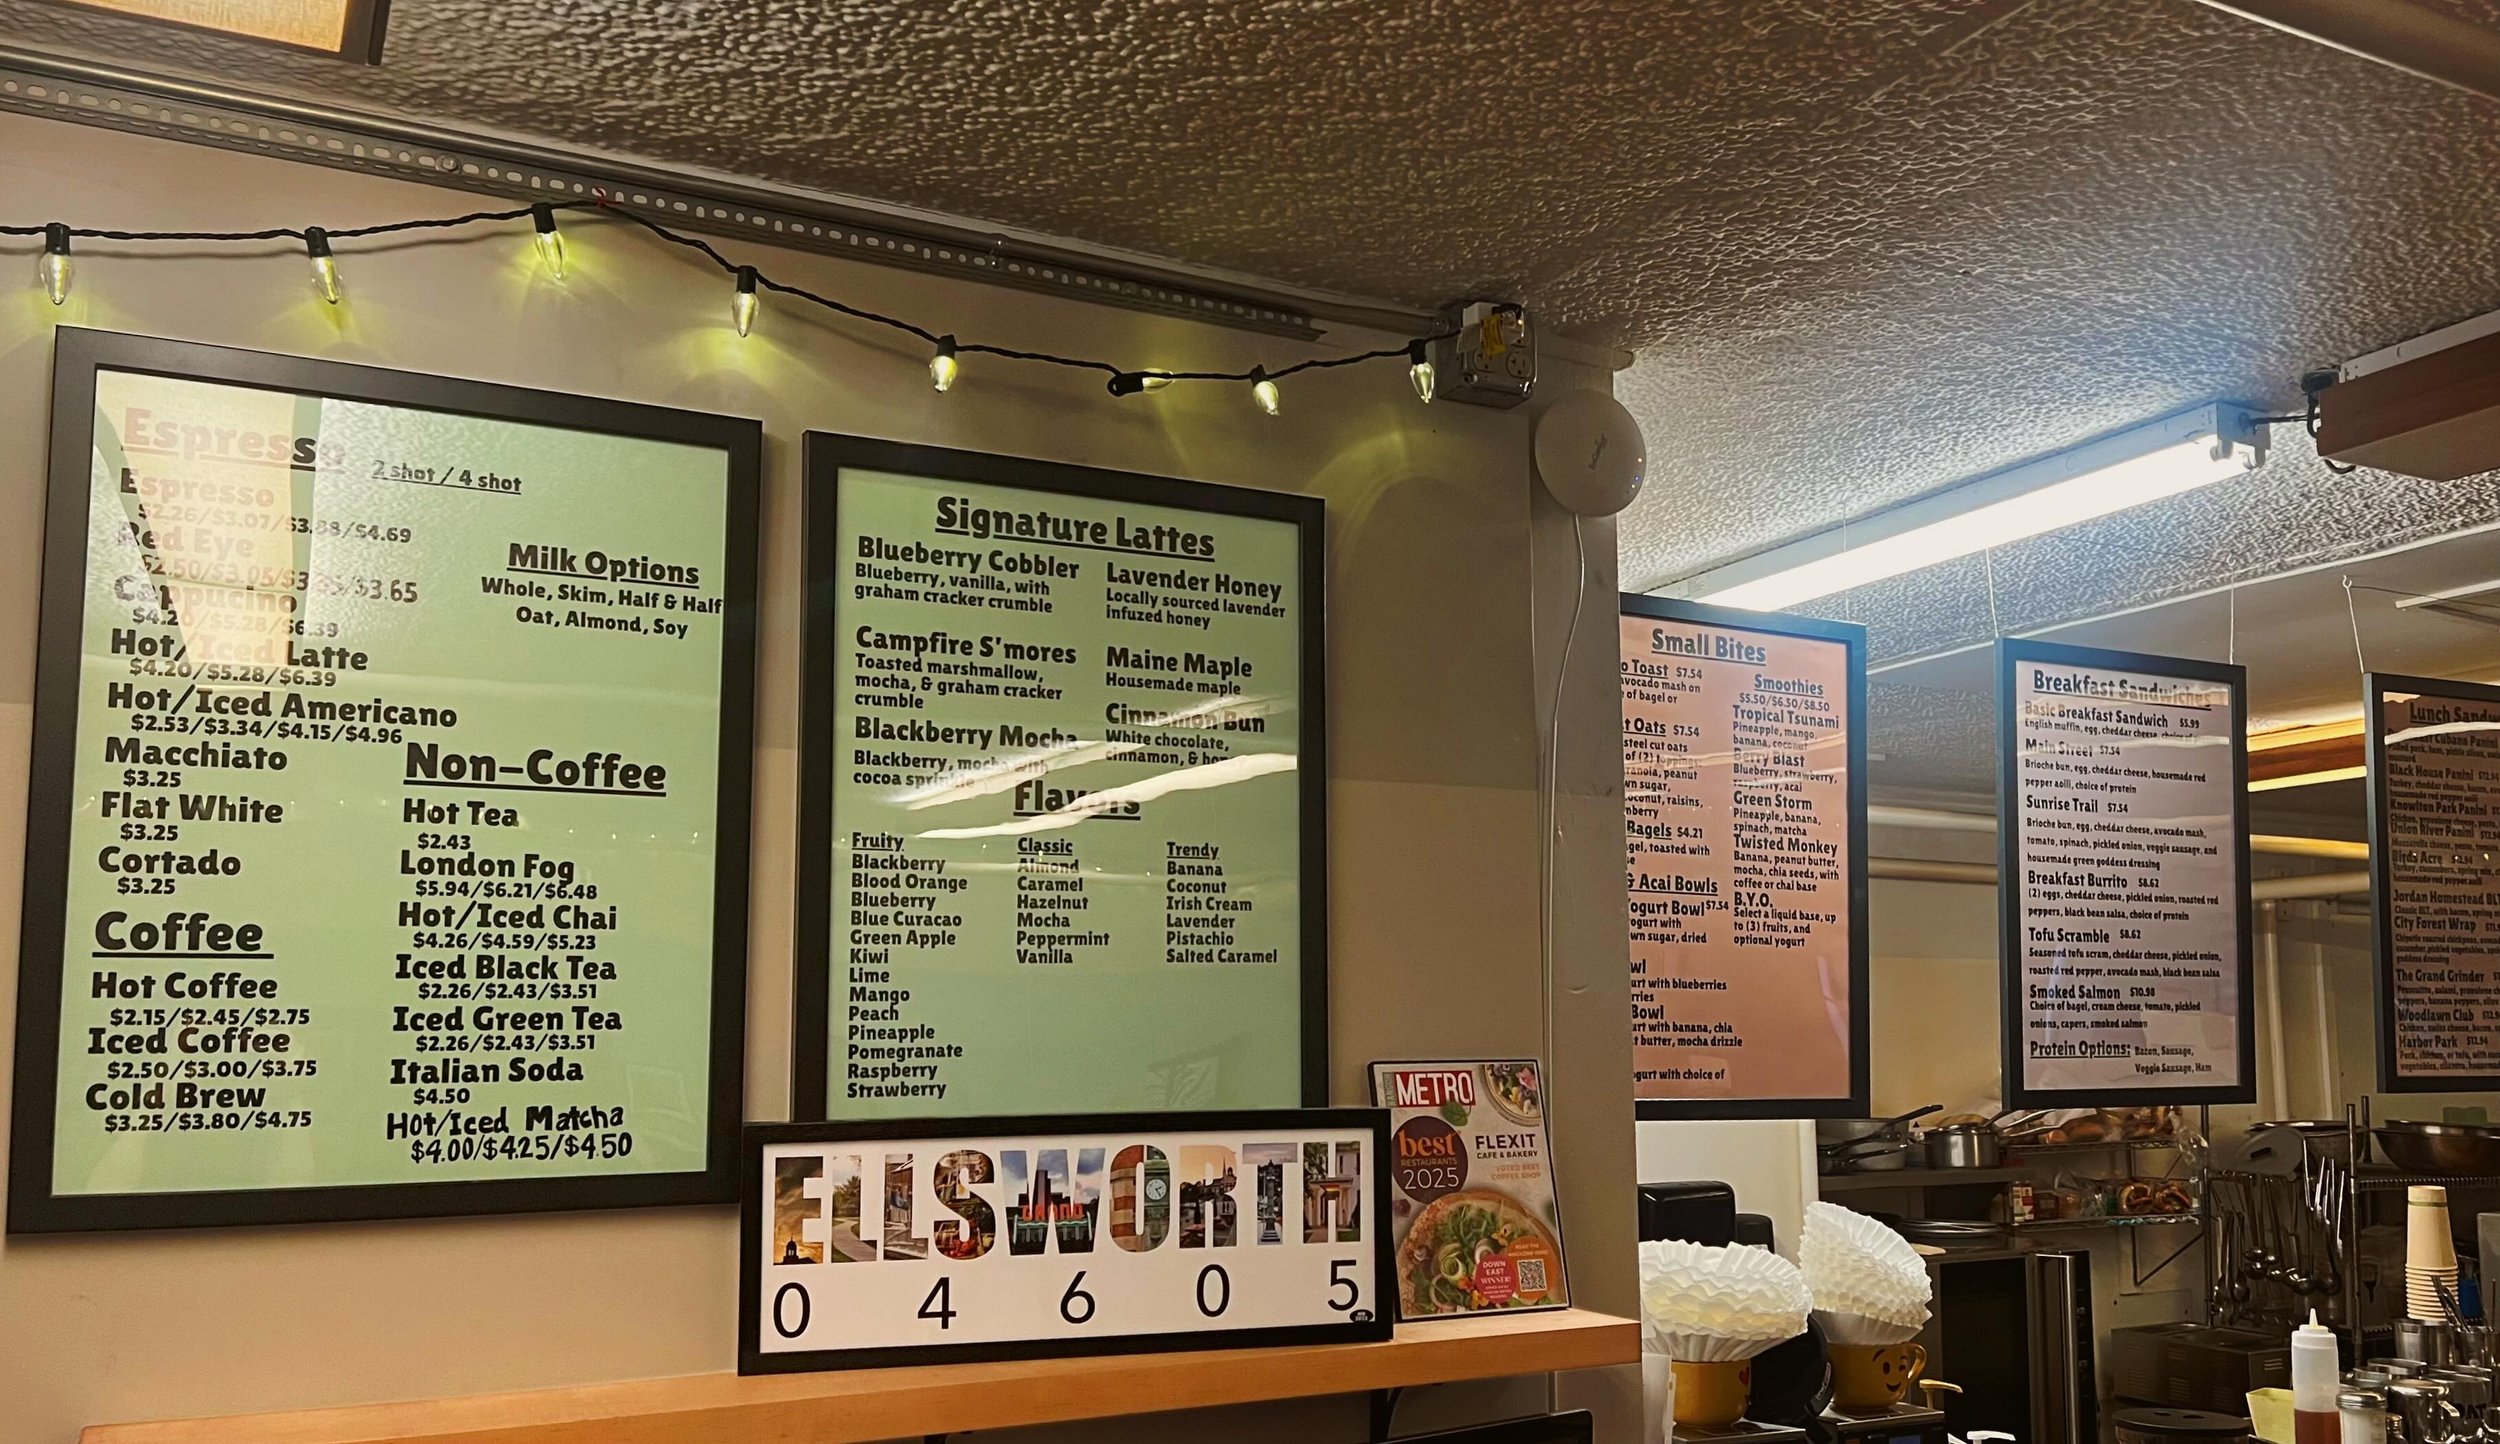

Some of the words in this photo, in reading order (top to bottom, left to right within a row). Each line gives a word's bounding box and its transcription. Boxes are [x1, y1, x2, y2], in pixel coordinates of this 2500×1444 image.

[373, 460, 385, 476] 2
[391, 463, 435, 482] shot
[440, 467, 454, 484] /
[459, 470, 472, 486] 4
[478, 473, 521, 491] shot
[121, 468, 274, 507] Espresso
[936, 497, 1107, 543] Signature
[1116, 517, 1215, 556] Lattes
[508, 543, 577, 573] Milk
[585, 551, 700, 586] Options
[858, 536, 982, 573] Blueberry
[989, 550, 1079, 579] Cobbler
[855, 563, 945, 587] Blueberry,
[949, 573, 1011, 595] vanilla,
[1015, 577, 1050, 596] with
[1107, 563, 1209, 593] Lavender
[1215, 574, 1282, 603] Honey
[481, 577, 553, 601] Whole,
[558, 585, 613, 606] Skim,
[618, 590, 659, 609] Half
[664, 594, 677, 609] &
[682, 596, 723, 614] Half
[855, 584, 919, 602] graham
[924, 589, 984, 608] cracker
[988, 595, 1053, 613] crumble
[516, 606, 560, 627] Oat,
[565, 610, 649, 635] Almond,
[654, 619, 688, 640] Soy
[1106, 606, 1162, 624] infuzed
[1167, 611, 1210, 630] honey
[856, 626, 973, 658] Campfire
[980, 635, 1076, 663] S'mores
[1652, 629, 1709, 655] Small
[1716, 636, 1766, 662] Bites
[129, 658, 337, 687] $4.20/$5.28/$6.39
[1107, 646, 1177, 672] Maine
[1183, 653, 1252, 680] Maple
[1106, 672, 1193, 693] Housemade
[1197, 679, 1240, 697] maple
[1755, 675, 1823, 695] Smoothies
[2034, 670, 2114, 696] Breakfast
[108, 682, 272, 717] Hot/Iced
[281, 693, 455, 728] Americano
[1740, 693, 1829, 711] $5.50/$6.50/$8.50
[2410, 702, 2450, 722] Lunch
[1733, 706, 1784, 724] Tropical
[1787, 713, 1839, 728] Tsunami
[131, 714, 402, 744] $2.53/$3.34/$4.15/$4.96
[855, 716, 992, 750] Blackberry
[1000, 725, 1078, 749] Mocha
[105, 737, 287, 770] Macchiato
[406, 742, 666, 790] Non-Coffee
[2415, 765, 2443, 779] House
[2445, 767, 2473, 780] Panini
[123, 769, 181, 788] $3.25
[102, 791, 170, 819] Flat
[179, 794, 283, 823] White
[1734, 791, 1773, 806] Green
[1776, 794, 1812, 810] Storm
[2027, 795, 2069, 810] Sunrise
[2073, 798, 2098, 812] Trail
[2108, 803, 2128, 813] $7.54
[403, 798, 459, 824] Hot
[467, 801, 519, 826] Tea
[120, 822, 178, 841] $3.25
[1627, 821, 1671, 837] Bagels
[1677, 826, 1702, 838] $4.21
[1734, 823, 1772, 837] spinach,
[1775, 825, 1807, 836] matcha
[417, 832, 471, 850] $2.43
[852, 832, 904, 853] Fruity
[1017, 837, 1073, 854] Classic
[1167, 842, 1219, 859] Trendy
[1734, 834, 1784, 850] Twisted
[1788, 838, 1838, 857] Monkey
[99, 846, 241, 875] Cortado
[401, 850, 515, 877] London
[524, 854, 574, 887] Fog
[852, 854, 946, 874] Blackberry
[1167, 879, 1227, 894] Coconut
[2029, 871, 2085, 886] Breakfast
[2087, 873, 2128, 888] Burrito
[2138, 878, 2159, 887] $8.62
[1017, 894, 1088, 910] Hazelnut
[1167, 896, 1202, 911] Irish
[1206, 897, 1252, 912] Cream
[1734, 892, 1773, 908] B.Y.O.
[95, 911, 263, 951] Coffee
[2029, 928, 2054, 942] Tofu
[2057, 928, 2110, 943] Scramble
[2394, 917, 2413, 931] City
[2416, 917, 2446, 930] Forest
[2449, 918, 2477, 934] Wrap
[1017, 931, 1110, 950] Peppermint
[1167, 932, 1234, 946] Pistachio
[1734, 936, 1773, 948] optional
[1775, 937, 1805, 949] yogurt
[850, 948, 889, 964] Kiwi
[1016, 949, 1073, 964] Vanilla
[1167, 949, 1214, 963] Salted
[1217, 948, 1278, 963] Caramel
[395, 954, 466, 979] Iced
[476, 955, 559, 979] Black
[566, 956, 617, 980] Tea
[850, 968, 890, 983] Lime
[2396, 969, 2413, 982] The
[2416, 969, 2445, 982] Grand
[2447, 970, 2485, 982] Grinder
[92, 972, 156, 998] Hot
[165, 972, 278, 998] Coffee
[418, 981, 597, 1001] $2.26/$2.43/$3.51
[2030, 985, 2075, 999] Smoked
[2079, 986, 2120, 999] Salmon
[850, 987, 910, 1006] Mango
[110, 1007, 310, 1027] $2.15/$2.45/$2.75
[849, 1006, 899, 1021] Peach
[849, 1025, 935, 1043] Pineapple
[848, 1044, 963, 1062] Pomegranate
[2030, 1041, 2076, 1056] Protein
[2079, 1041, 2130, 1058] Options:
[390, 1058, 500, 1084] Italian
[508, 1057, 584, 1081] Soda
[848, 1063, 938, 1081] Raspberry
[85, 1083, 165, 1110] Cold
[176, 1082, 266, 1108] Brew
[414, 1088, 470, 1106] $4.50
[847, 1082, 947, 1099] Strawberry
[1396, 1072, 1473, 1105] METRO
[105, 1111, 312, 1133] $3.25/$3.80/$4.75
[387, 1106, 509, 1140] Hot/Iced
[526, 1106, 624, 1131] Matcha
[411, 1132, 632, 1164] $4.00/$4.25/$4.50
[1398, 1129, 1456, 1157] best
[1475, 1134, 1535, 1149] FLEXIT
[1401, 1158, 1457, 1167] RESTAURANTS
[1403, 1168, 1459, 1189] 2025
[773, 1141, 1361, 1265] ELLSWORTH
[773, 1282, 811, 1338] 0
[917, 1277, 957, 1329] 4
[1061, 1270, 1096, 1324] 6
[1196, 1264, 1230, 1317] 0
[1327, 1260, 1358, 1311] 5
